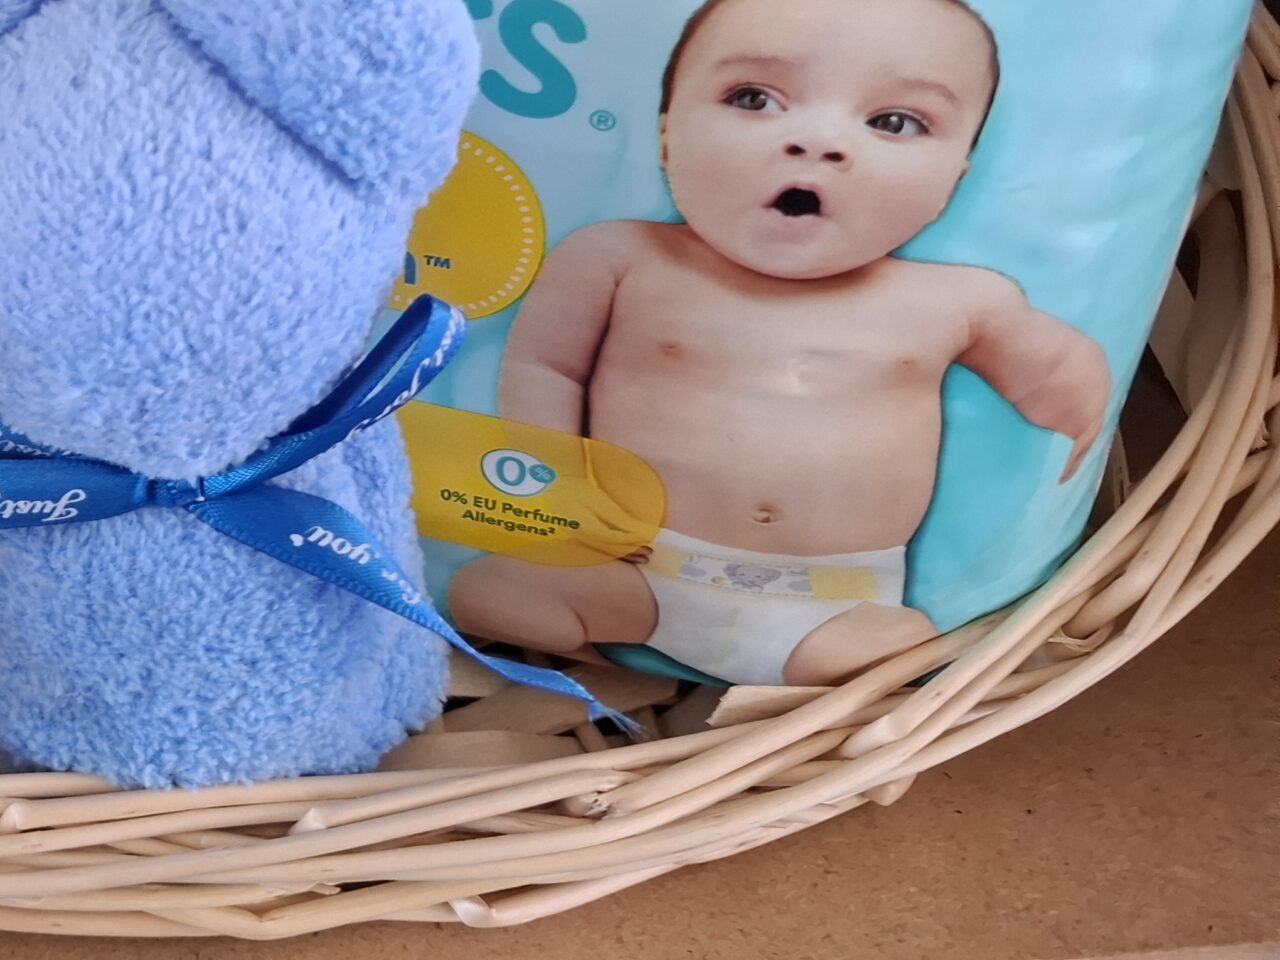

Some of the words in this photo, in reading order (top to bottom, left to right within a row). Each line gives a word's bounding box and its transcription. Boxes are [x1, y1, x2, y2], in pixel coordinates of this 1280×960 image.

[496, 455, 557, 487] 0%
[440, 489, 468, 506] 0%
[473, 495, 496, 510] EU
[502, 502, 581, 530] Perfume
[304, 525, 381, 565] you
